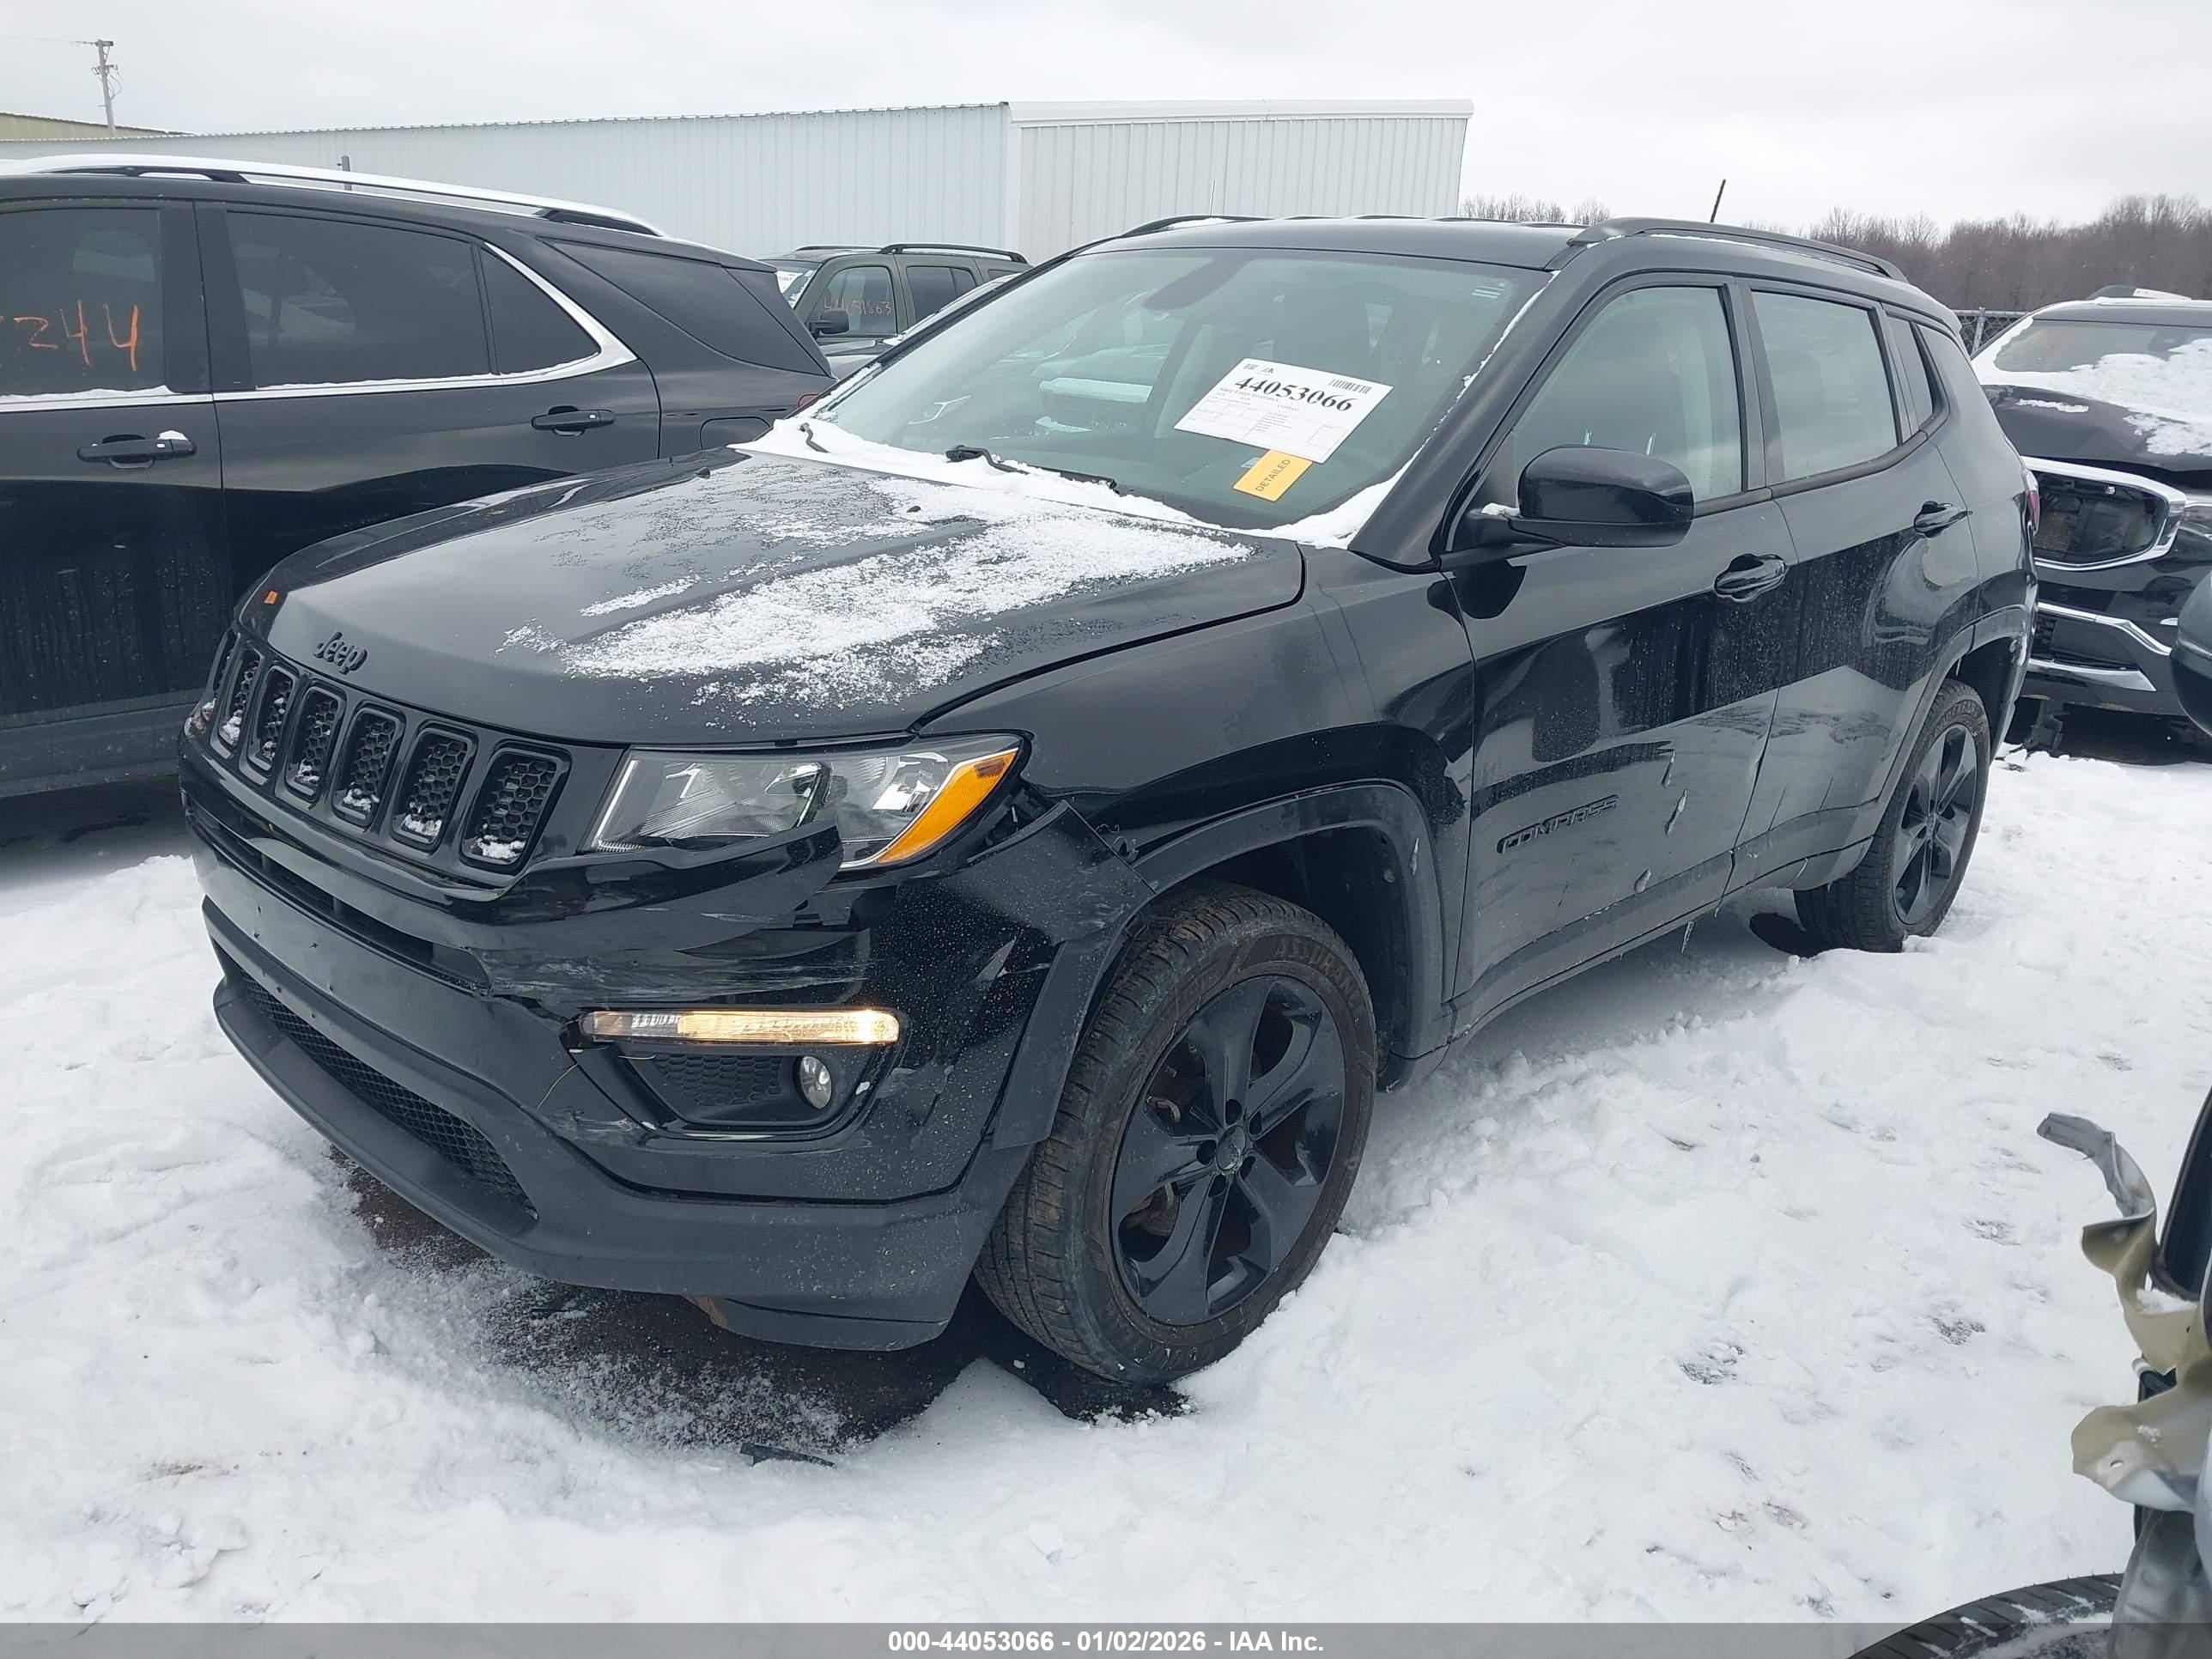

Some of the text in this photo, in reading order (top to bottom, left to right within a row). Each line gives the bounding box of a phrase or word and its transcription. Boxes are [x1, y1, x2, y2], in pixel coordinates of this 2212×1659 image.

[0, 300, 138, 371] 244
[1234, 376, 1358, 411] 44053066
[1255, 459, 1291, 492] DETAILED
[313, 631, 368, 675] Jeep
[1497, 794, 1620, 853] COMPASS
